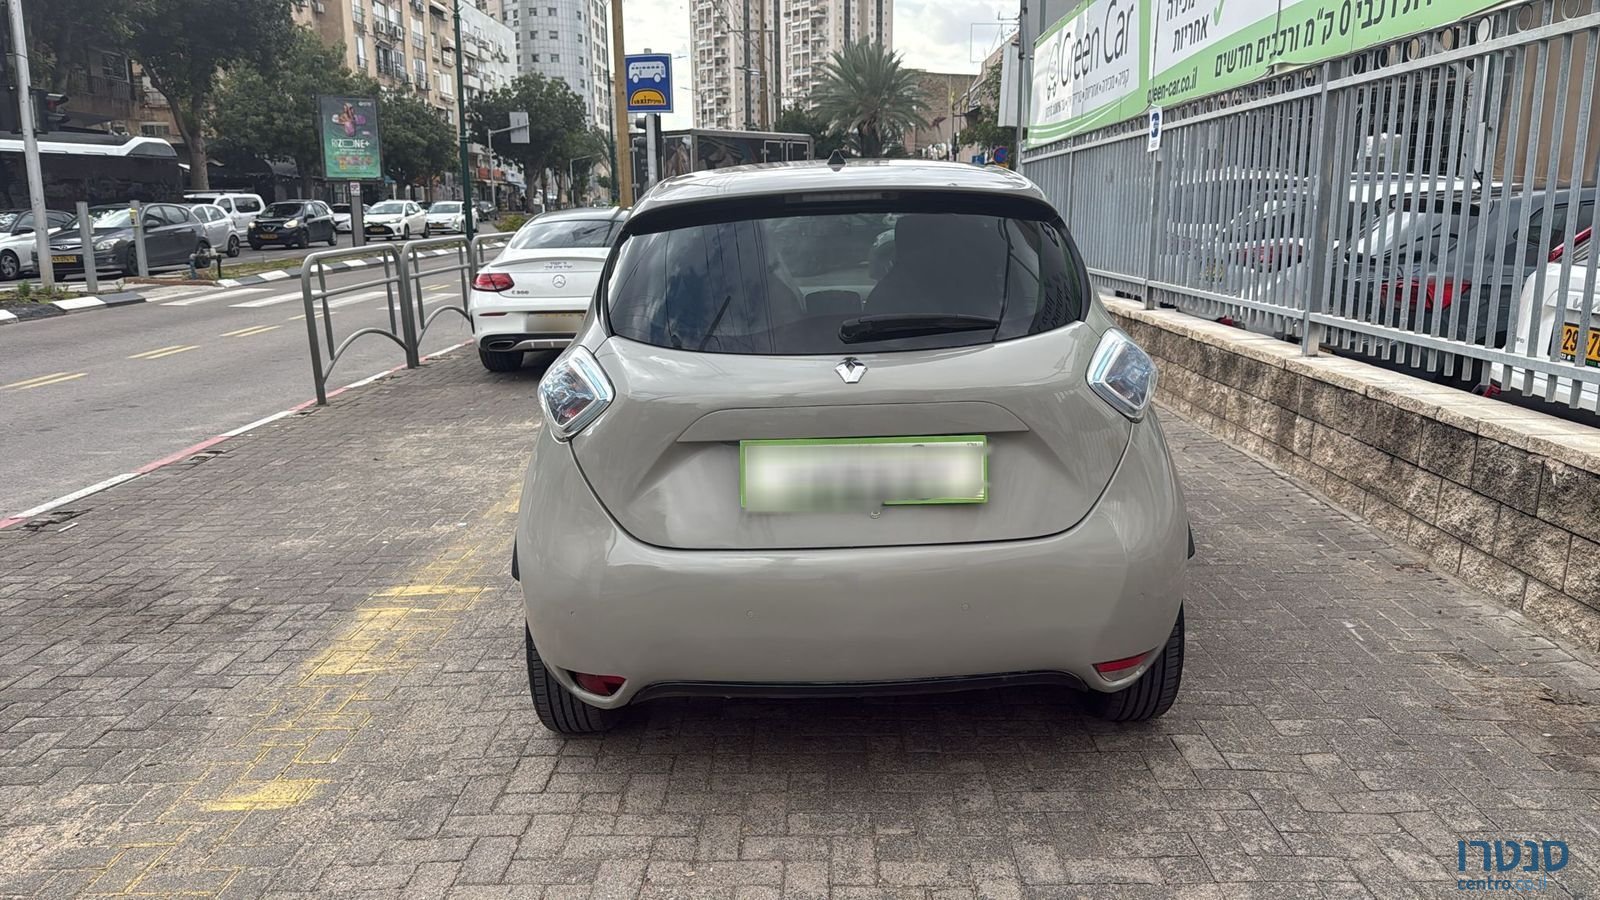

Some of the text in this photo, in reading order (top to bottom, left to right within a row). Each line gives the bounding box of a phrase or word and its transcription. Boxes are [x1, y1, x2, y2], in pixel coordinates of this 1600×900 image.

[1061, 0, 1134, 87] Green Car
[1172, 13, 1210, 53] אחריות
[1255, 24, 1301, 63] ורכבים
[1214, 42, 1254, 78] חדשים
